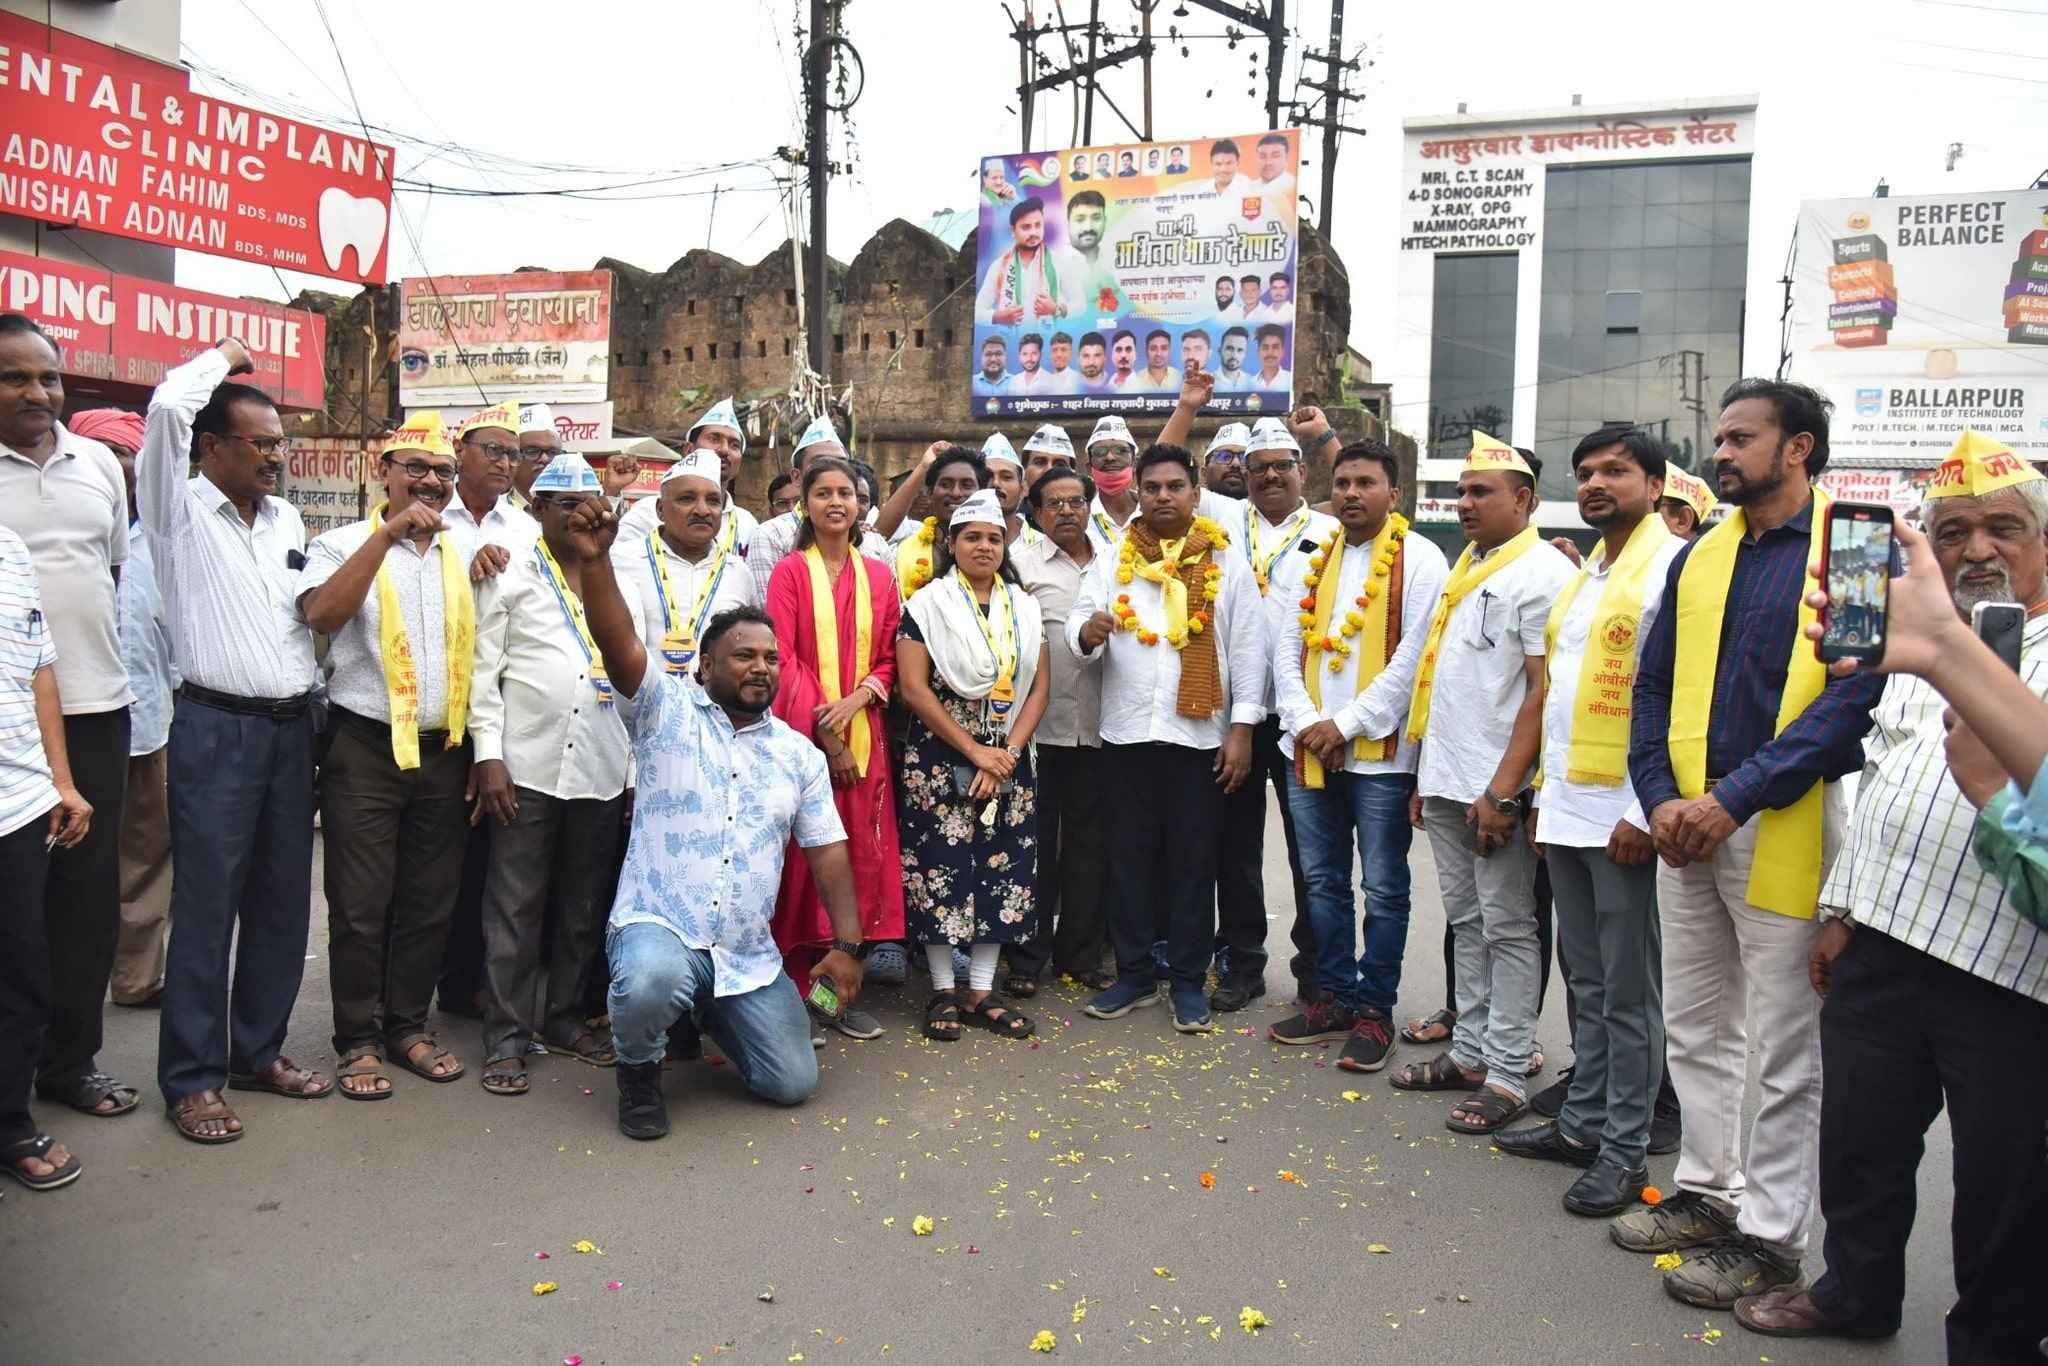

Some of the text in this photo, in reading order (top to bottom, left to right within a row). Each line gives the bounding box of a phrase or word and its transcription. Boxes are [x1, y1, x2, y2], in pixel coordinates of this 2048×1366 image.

[162, 95, 184, 126] &
[198, 100, 389, 181] IMPLANT
[101, 121, 266, 181] CLINIC
[3, 133, 118, 187] ADNAN
[141, 164, 230, 212] FAHIM
[276, 211, 307, 229] MDS
[1485, 167, 1525, 182] SCAN
[1408, 183, 1533, 201] 4-D SONOGRAPHY
[1481, 201, 1511, 215] OPG
[1897, 202, 2006, 225] PERFECT
[0, 172, 113, 225] NISHAT
[123, 201, 227, 249] ADNAN
[273, 248, 307, 265] MHM
[1413, 216, 1527, 233] MAMMOGRAPHY
[1401, 232, 1536, 250] HITECH PATHOLOGY
[1897, 224, 2004, 247] BALANCE
[1838, 242, 1871, 256] Sports
[504, 289, 602, 336] दवाखाना
[137, 292, 301, 358] INSTITUTE
[1889, 388, 2024, 408] BALLARPUR
[1888, 409, 2025, 418] INSTITUTE OF TECHNOLOGY
[1852, 424, 1875, 432] POLY
[1971, 424, 1993, 432] MBA
[2000, 424, 2024, 432] MCA
[1980, 451, 2025, 478] जय
[1603, 658, 1624, 670] जय
[1592, 671, 1633, 688] ओबीसी
[1600, 689, 1621, 700] जय
[1588, 701, 1632, 718] संविधान
